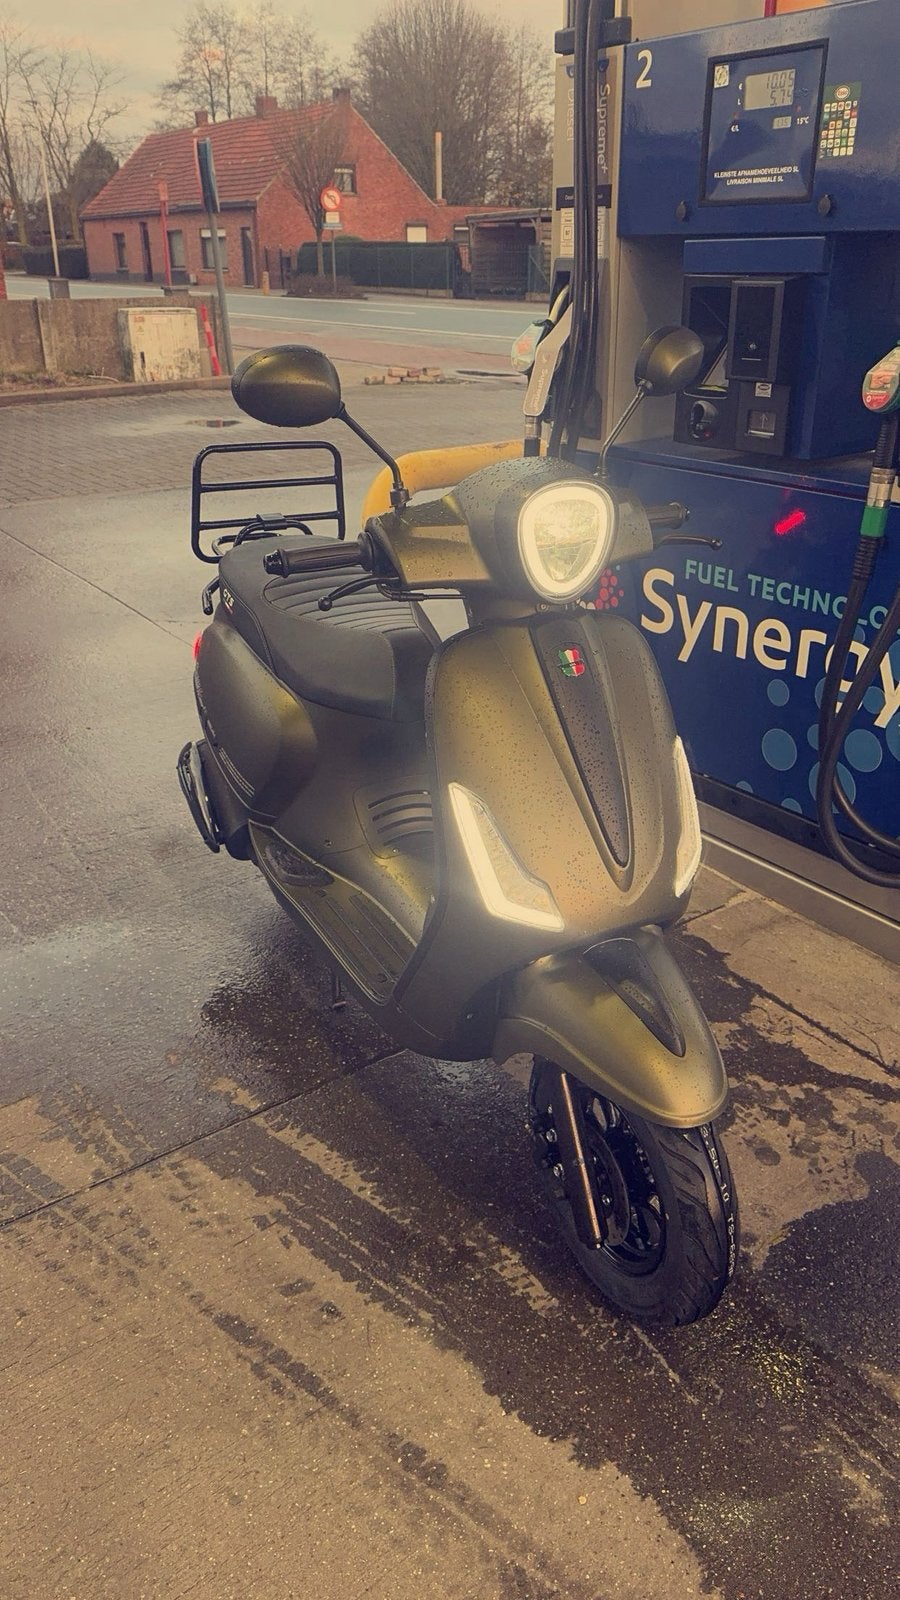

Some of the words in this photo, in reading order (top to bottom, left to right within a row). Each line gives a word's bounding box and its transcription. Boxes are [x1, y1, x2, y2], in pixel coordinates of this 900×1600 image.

[636, 49, 653, 89] 2
[596, 83, 611, 174] Supreme+
[714, 170, 737, 178] KLEINSTE
[726, 177, 752, 186] LIVRAISON
[685, 559, 739, 593] FUEL
[747, 573, 900, 635] TECHNOO
